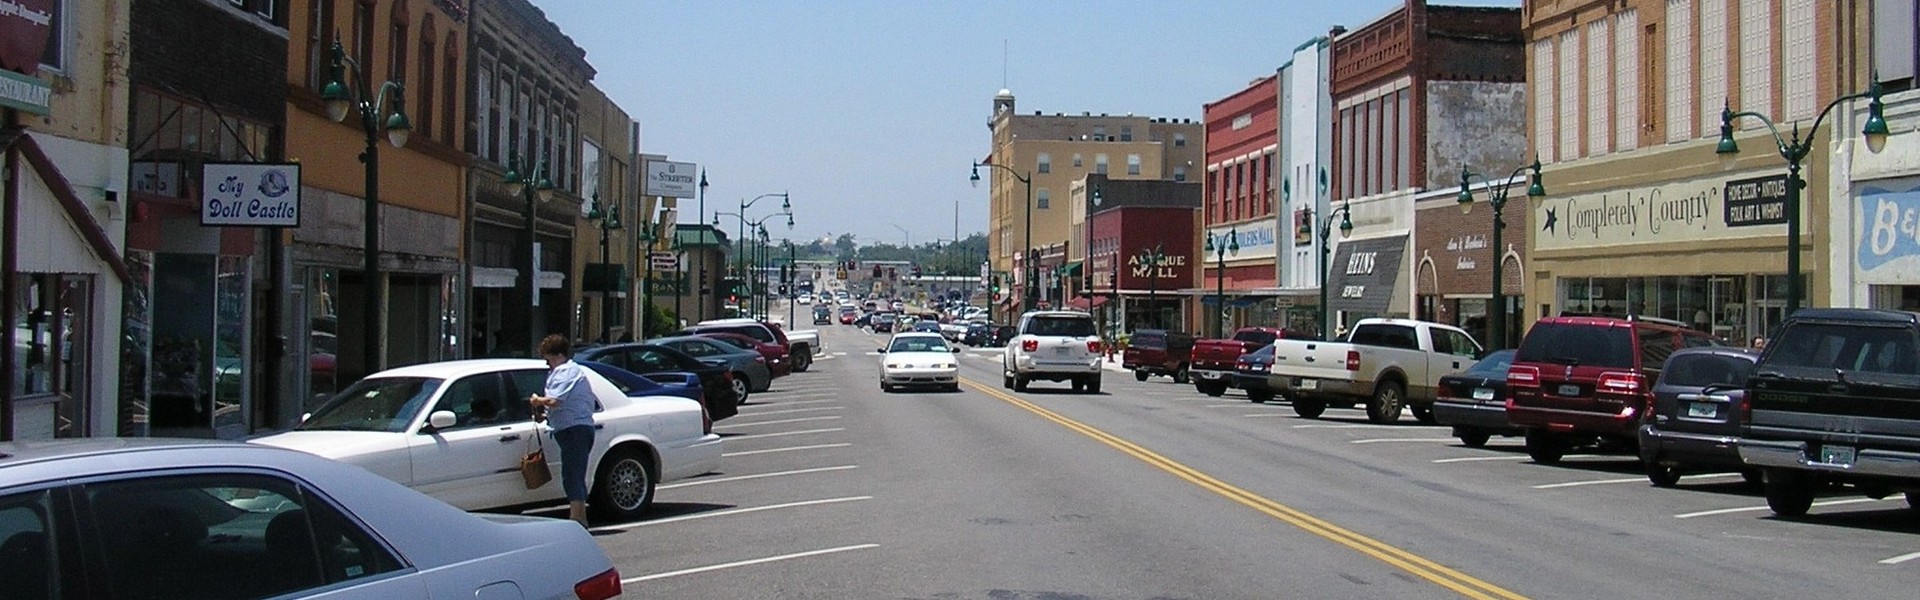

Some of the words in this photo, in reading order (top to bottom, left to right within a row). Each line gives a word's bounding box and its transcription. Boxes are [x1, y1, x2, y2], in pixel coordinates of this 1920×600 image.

[218, 175, 244, 198] My
[1761, 179, 1786, 199] ANTIQUES
[208, 198, 243, 218] Doll
[247, 198, 295, 218] Castle
[1566, 191, 1644, 241] Completely
[1649, 186, 1717, 235] Country
[1128, 255, 1185, 267] AQUE
[1346, 251, 1377, 275] HEINS
